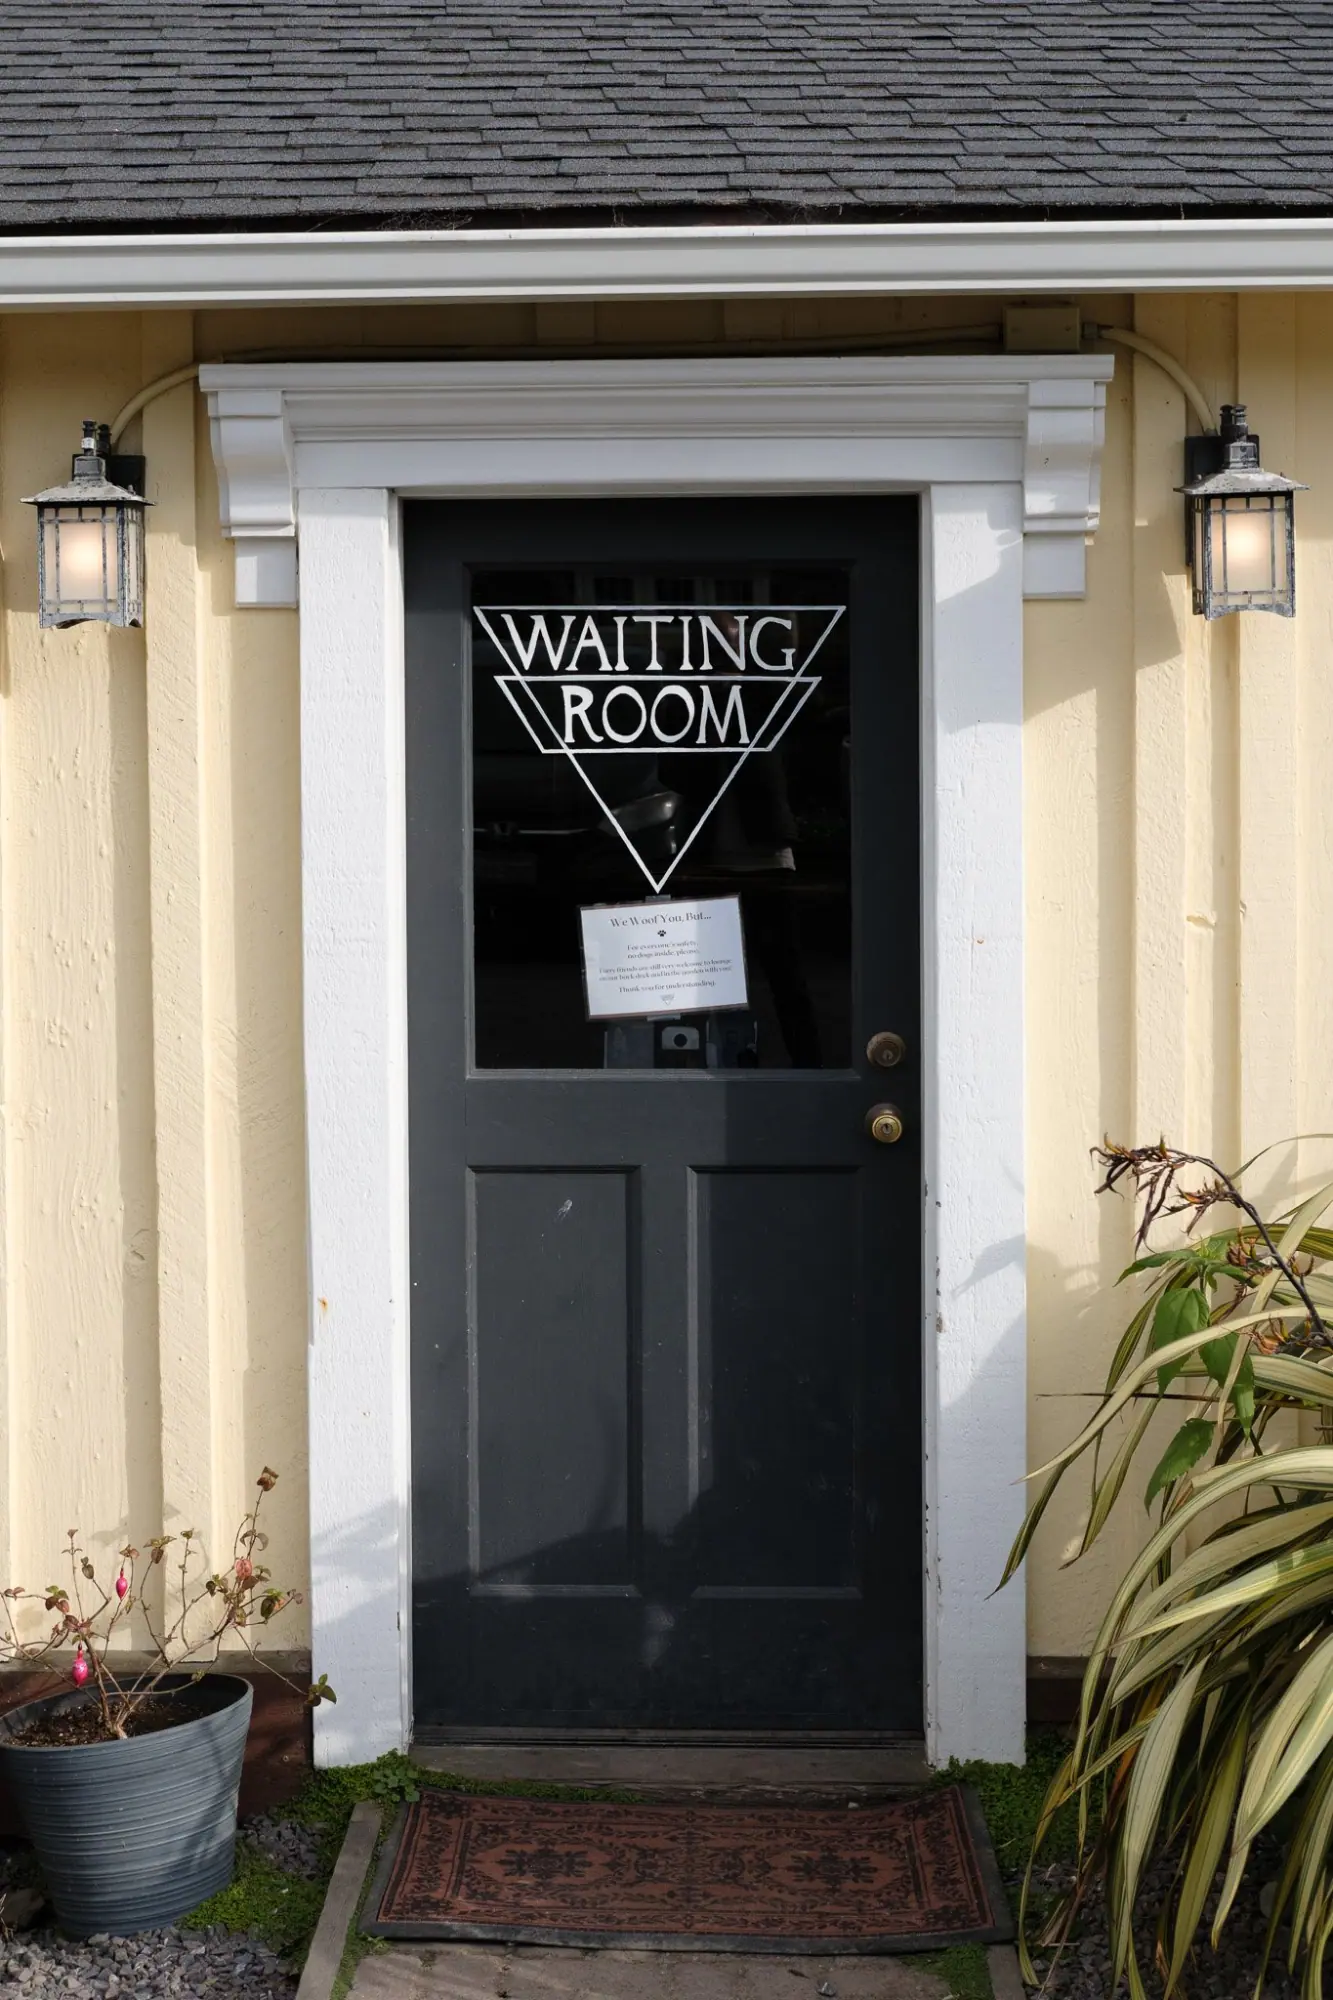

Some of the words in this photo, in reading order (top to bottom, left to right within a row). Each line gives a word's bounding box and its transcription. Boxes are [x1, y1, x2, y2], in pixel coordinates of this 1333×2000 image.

[502, 613, 797, 672] WAITING
[561, 685, 751, 744] ROOM
[610, 918, 628, 927] We
[630, 914, 659, 926] Woof
[660, 912, 685, 924] You,
[686, 911, 712, 921] But...
